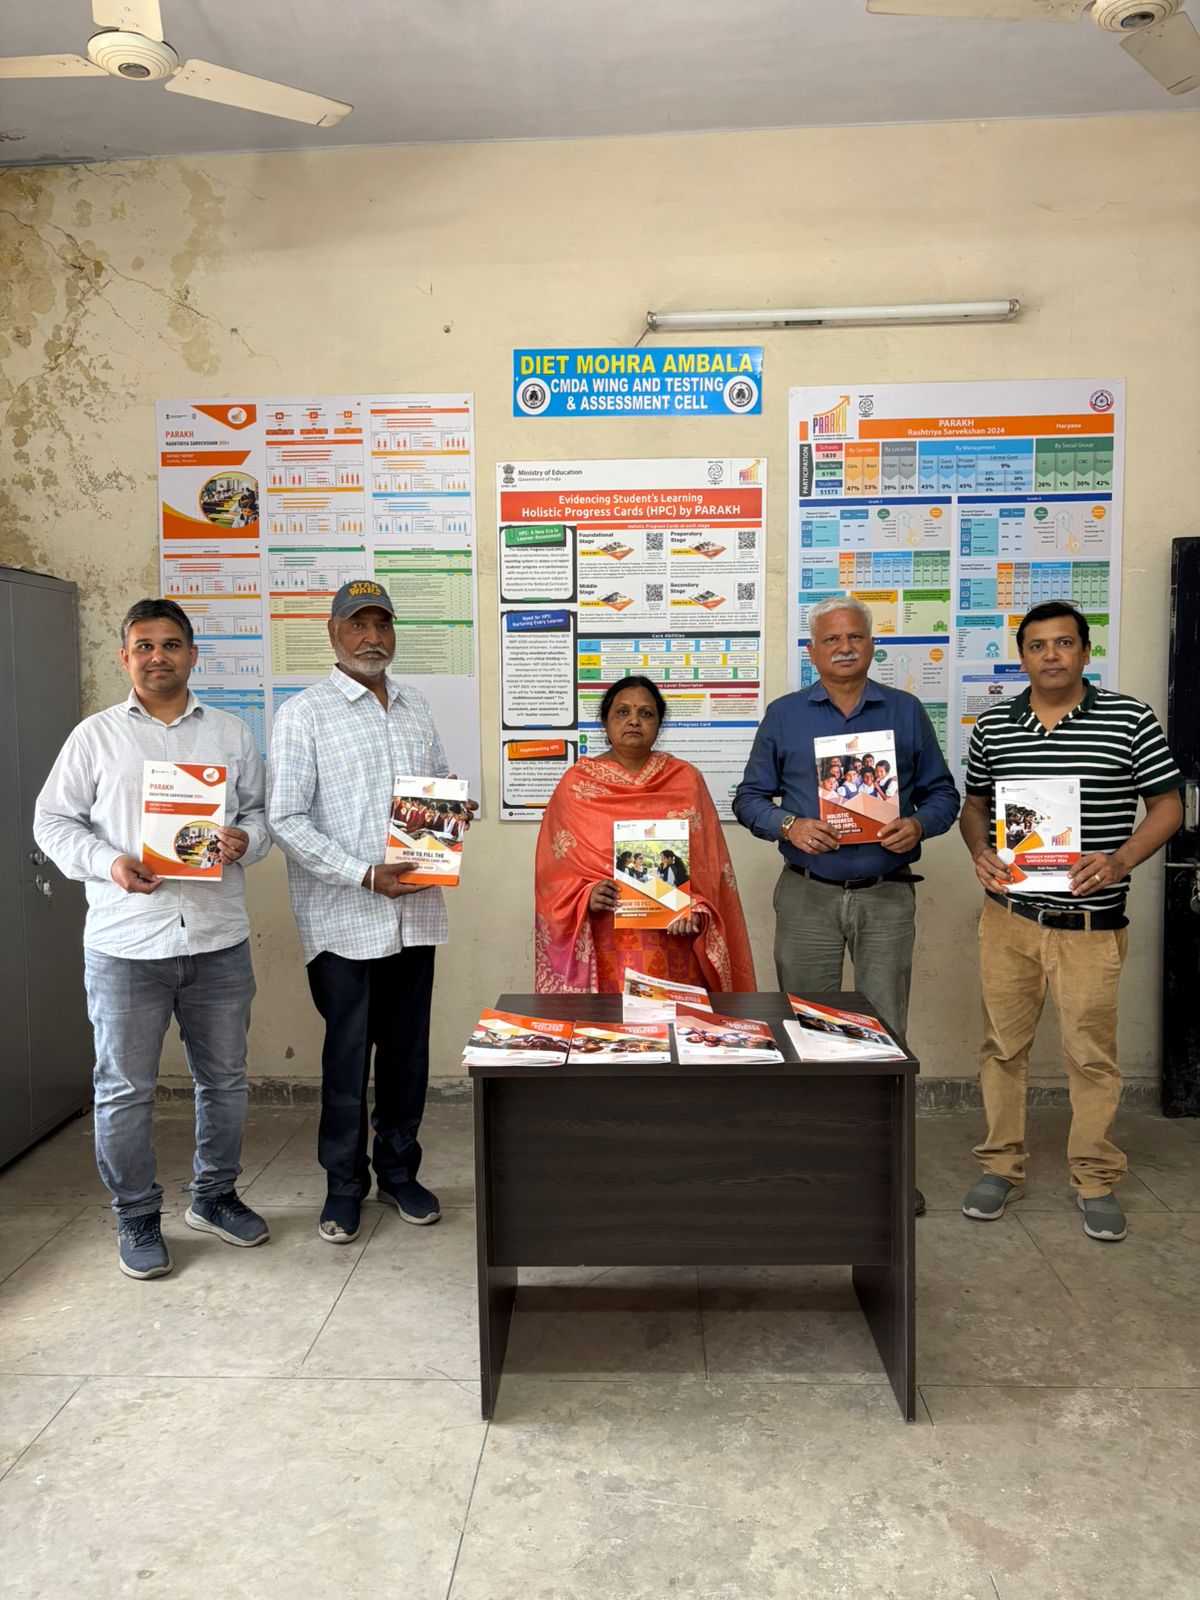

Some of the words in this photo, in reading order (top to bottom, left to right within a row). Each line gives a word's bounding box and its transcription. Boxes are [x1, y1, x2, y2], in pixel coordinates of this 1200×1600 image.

[520, 356, 570, 374] DIET
[577, 354, 656, 374] MOHRA
[663, 354, 753, 373] AMBALA
[551, 379, 588, 393] CMDA
[593, 378, 628, 392] WING
[634, 378, 661, 392] AND
[665, 377, 723, 391] TESTING
[566, 396, 576, 410] &
[580, 395, 670, 410] ASSESSMENT
[674, 395, 708, 409] CELL
[908, 428, 942, 436] Rashtriya
[559, 495, 610, 506] Evidencing
[613, 494, 658, 504] Student's
[660, 494, 703, 505] Learning
[522, 507, 562, 517] Holistic
[565, 507, 609, 519] Progress
[613, 506, 643, 517] Cards
[646, 505, 677, 517] (HPC)
[679, 505, 692, 518] by
[695, 505, 740, 515] PARAKH
